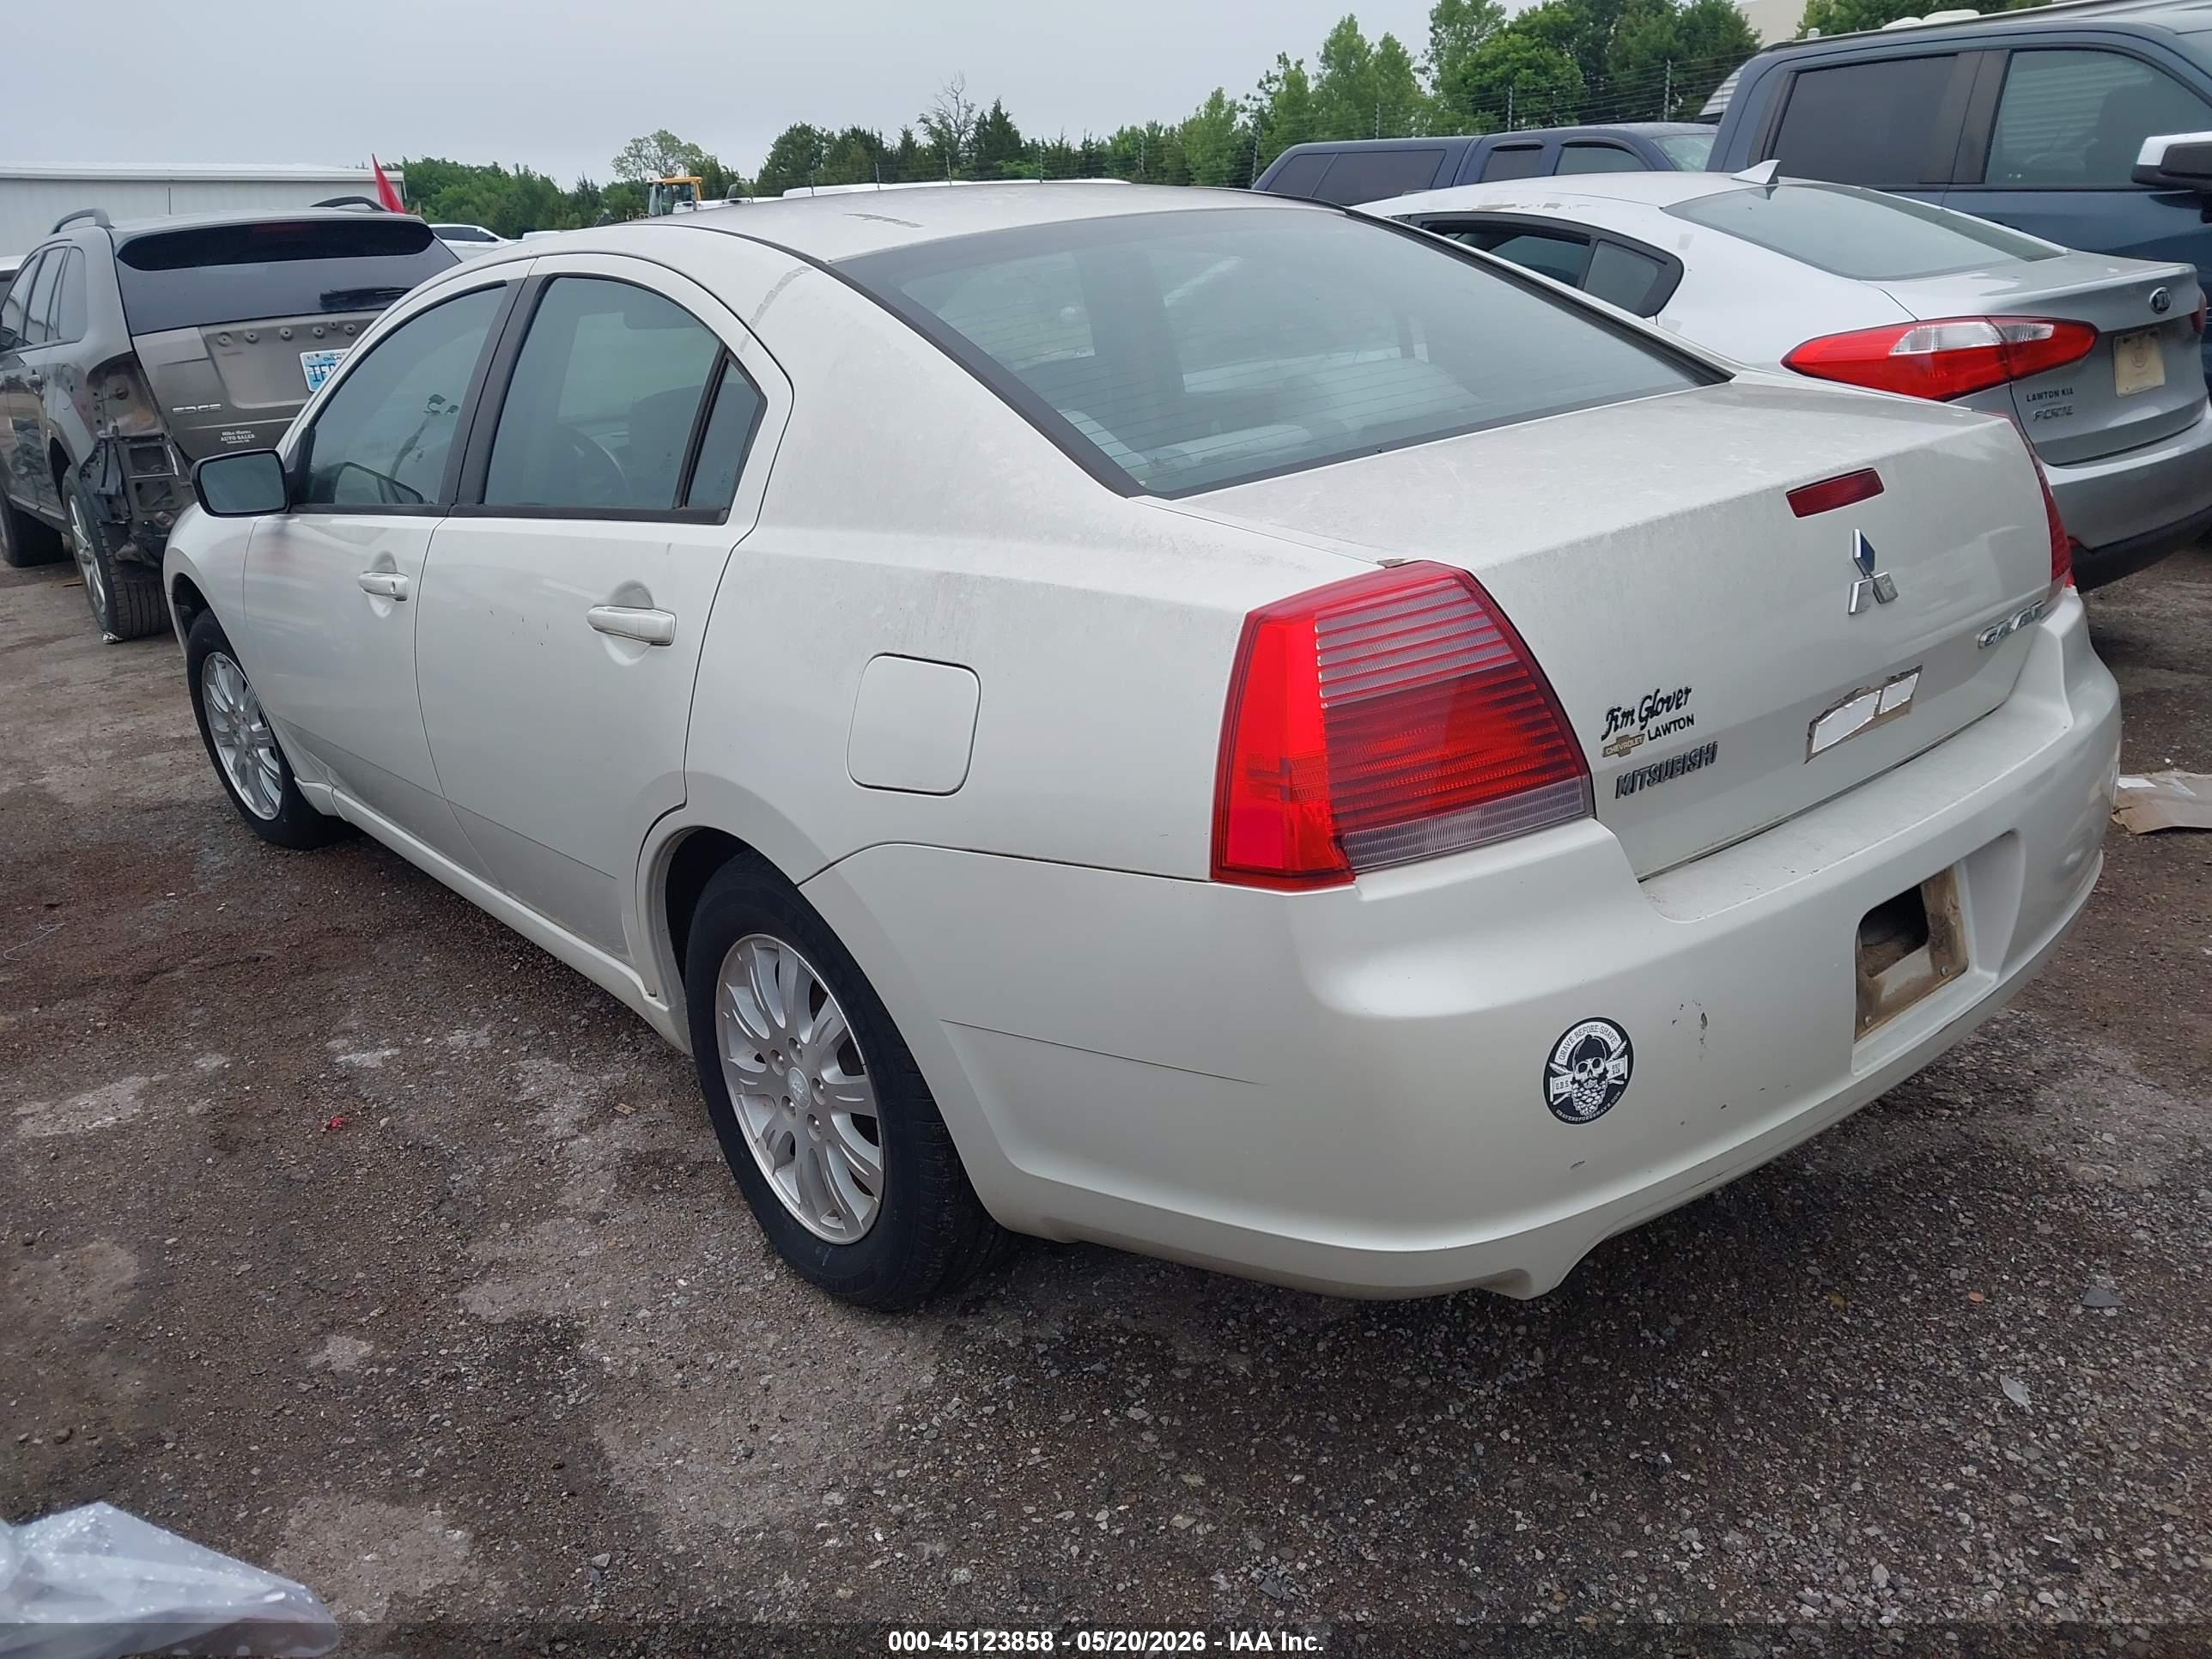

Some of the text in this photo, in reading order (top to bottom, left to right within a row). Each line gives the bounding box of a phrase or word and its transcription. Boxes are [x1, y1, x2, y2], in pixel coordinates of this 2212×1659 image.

[2027, 389, 2060, 402] LAWTON
[1601, 686, 1692, 741] Jim Glover
[1606, 713, 1695, 756] CHEVROLET LAWTON
[1615, 740, 1718, 799] MITSUBISHI
